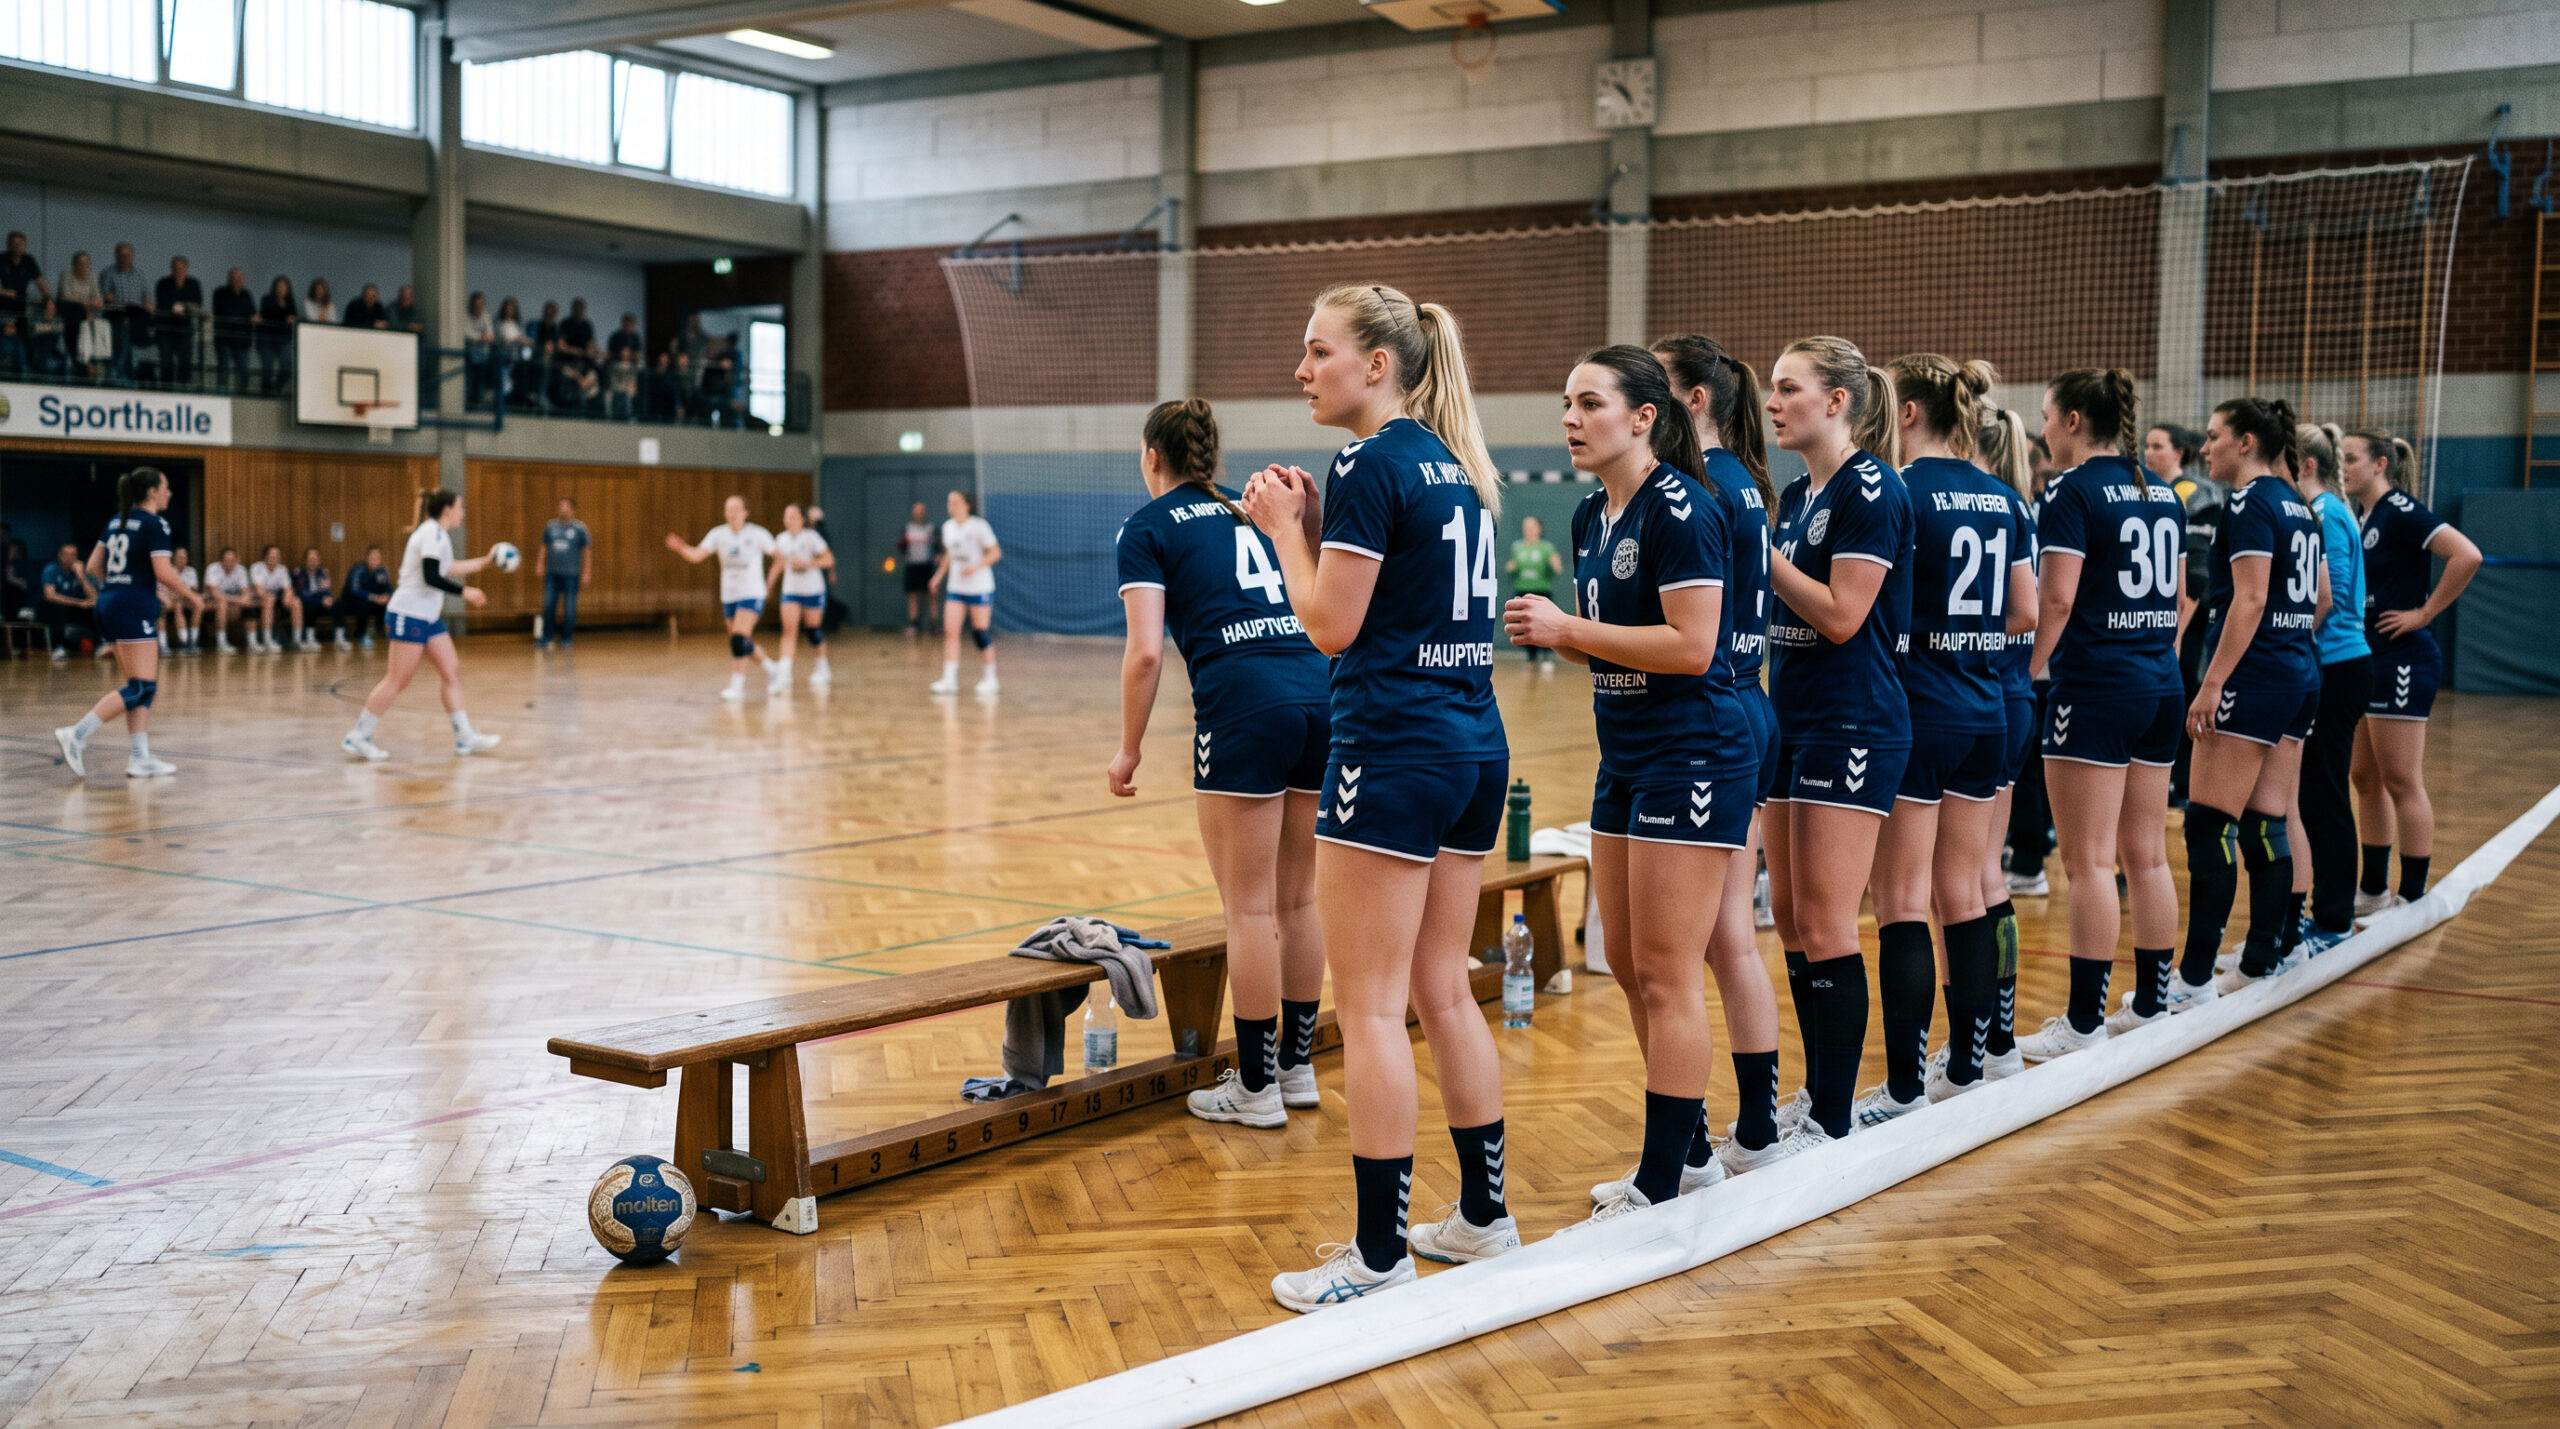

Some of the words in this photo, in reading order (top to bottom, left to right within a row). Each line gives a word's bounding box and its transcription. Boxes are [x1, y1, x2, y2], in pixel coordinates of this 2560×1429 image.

[39, 395, 211, 436] Sporthalle
[1235, 525, 1284, 604] 4
[1442, 505, 1498, 621] 14
[1948, 526, 2007, 616] 21
[2118, 517, 2179, 599] 30
[2287, 529, 2320, 604] 30
[1587, 578, 1600, 622] 8
[1638, 812, 1675, 825] hummel
[830, 1163, 839, 1185] 1
[870, 1152, 881, 1174] 3
[909, 1141, 920, 1162] 4
[947, 1131, 957, 1153] 5
[982, 1122, 992, 1143] 6
[1018, 1111, 1029, 1133] 9
[1050, 1101, 1068, 1124] 17
[1117, 1084, 1135, 1106] 13
[1149, 1075, 1166, 1096] 16
[1182, 1066, 1198, 1088] 19
[616, 1196, 679, 1215] molten
